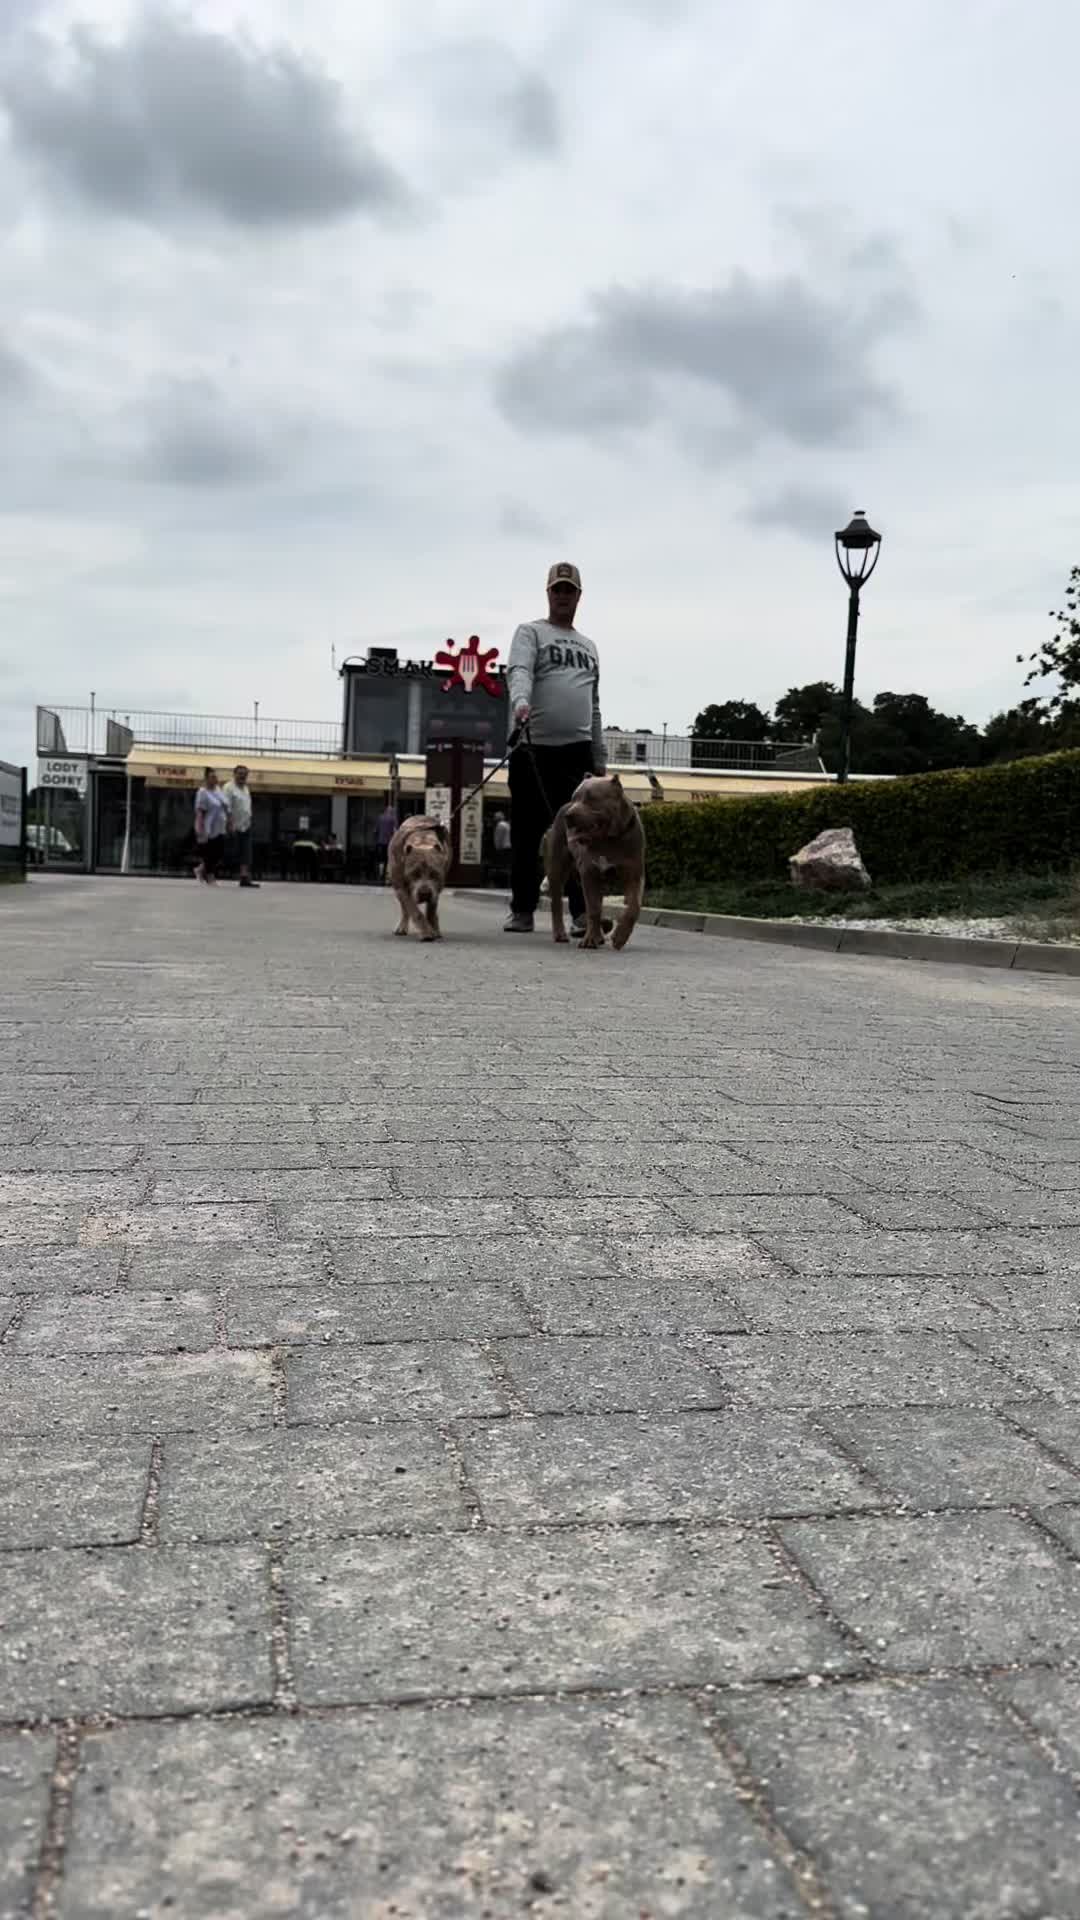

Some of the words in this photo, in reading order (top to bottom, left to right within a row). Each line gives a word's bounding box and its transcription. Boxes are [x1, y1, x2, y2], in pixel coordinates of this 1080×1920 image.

[548, 644, 598, 671] GANT
[366, 657, 433, 678] SMAK
[47, 762, 78, 773] LODY
[42, 774, 82, 785] GOFRY
